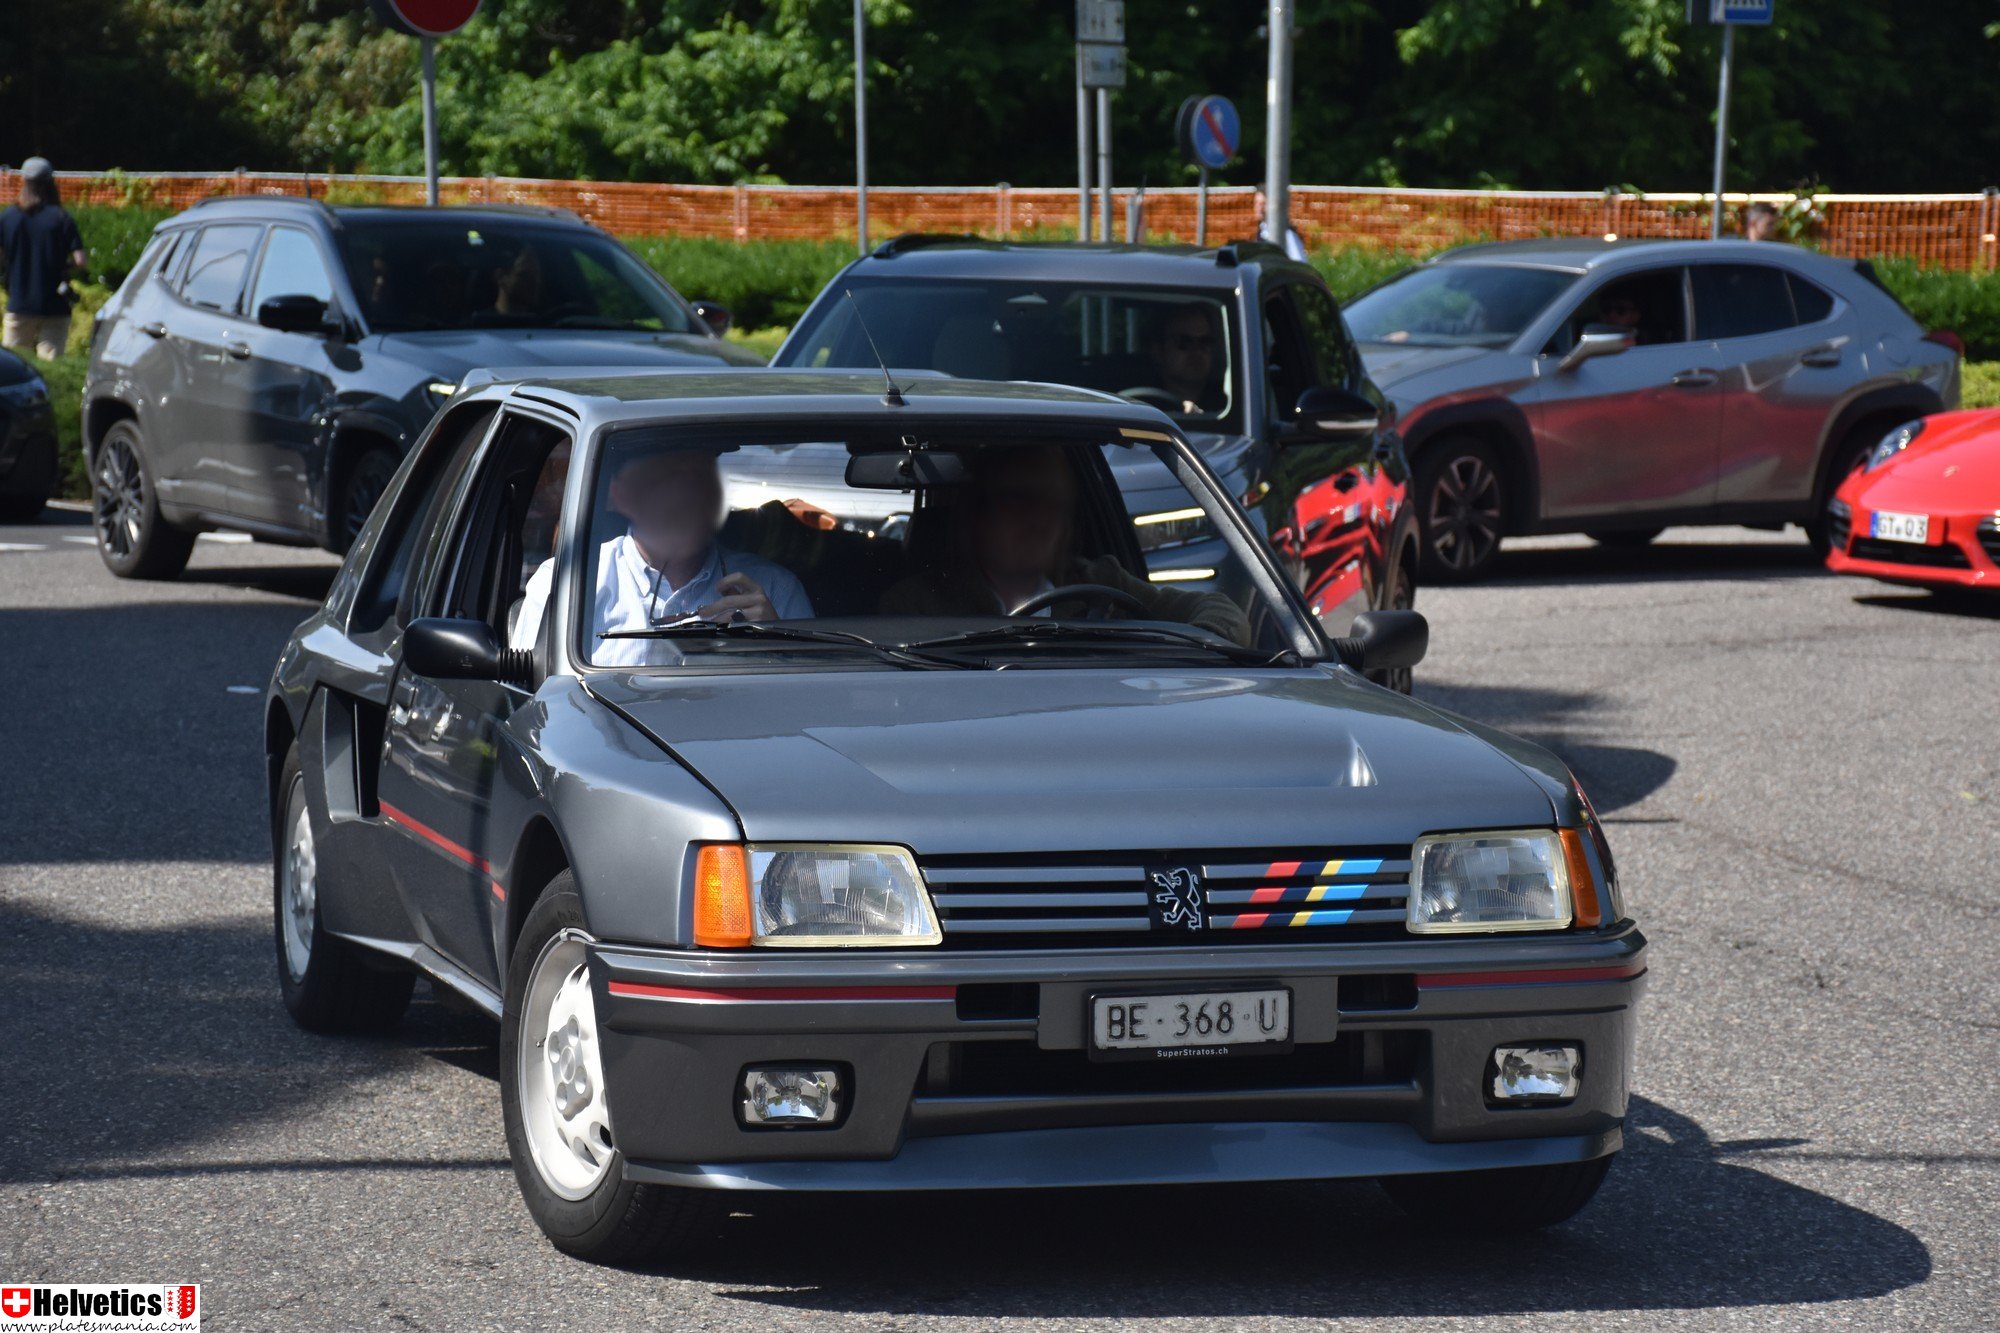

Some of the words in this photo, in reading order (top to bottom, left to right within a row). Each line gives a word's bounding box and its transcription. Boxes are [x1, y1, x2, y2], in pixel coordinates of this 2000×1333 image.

[1107, 1003, 1149, 1041] BE
[1173, 1000, 1235, 1038] 368
[1256, 997, 1278, 1034] U
[1156, 1047, 1229, 1058] SuperStratos.ch
